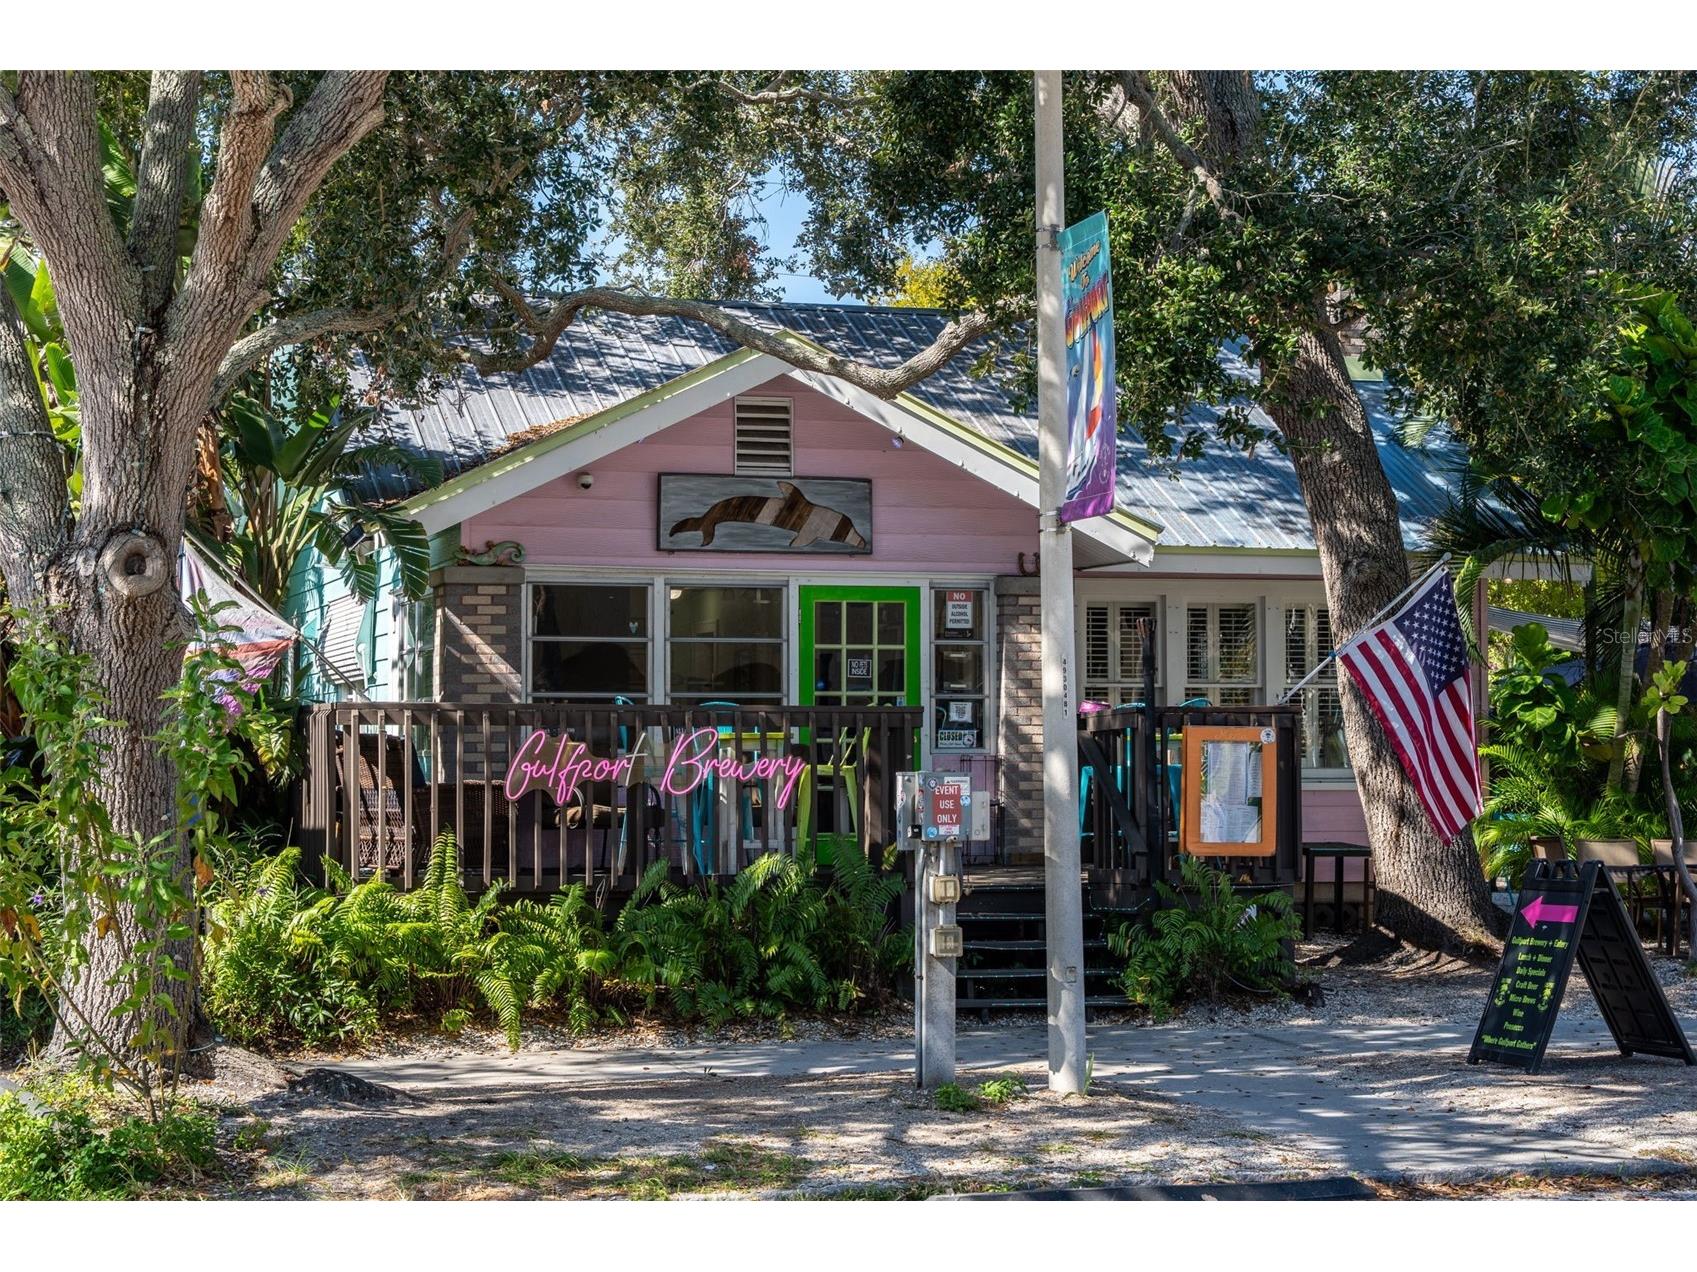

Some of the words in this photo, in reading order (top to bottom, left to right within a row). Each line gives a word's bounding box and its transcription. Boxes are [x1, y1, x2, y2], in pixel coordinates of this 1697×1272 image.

[953, 592, 966, 600] NO
[851, 661, 859, 669] NO
[940, 731, 963, 741] CLOSED
[504, 728, 648, 807] Gulfport
[660, 727, 805, 810] Brewery
[935, 785, 959, 795] EVENT
[939, 800, 955, 809] USE
[937, 814, 957, 824] ONLY
